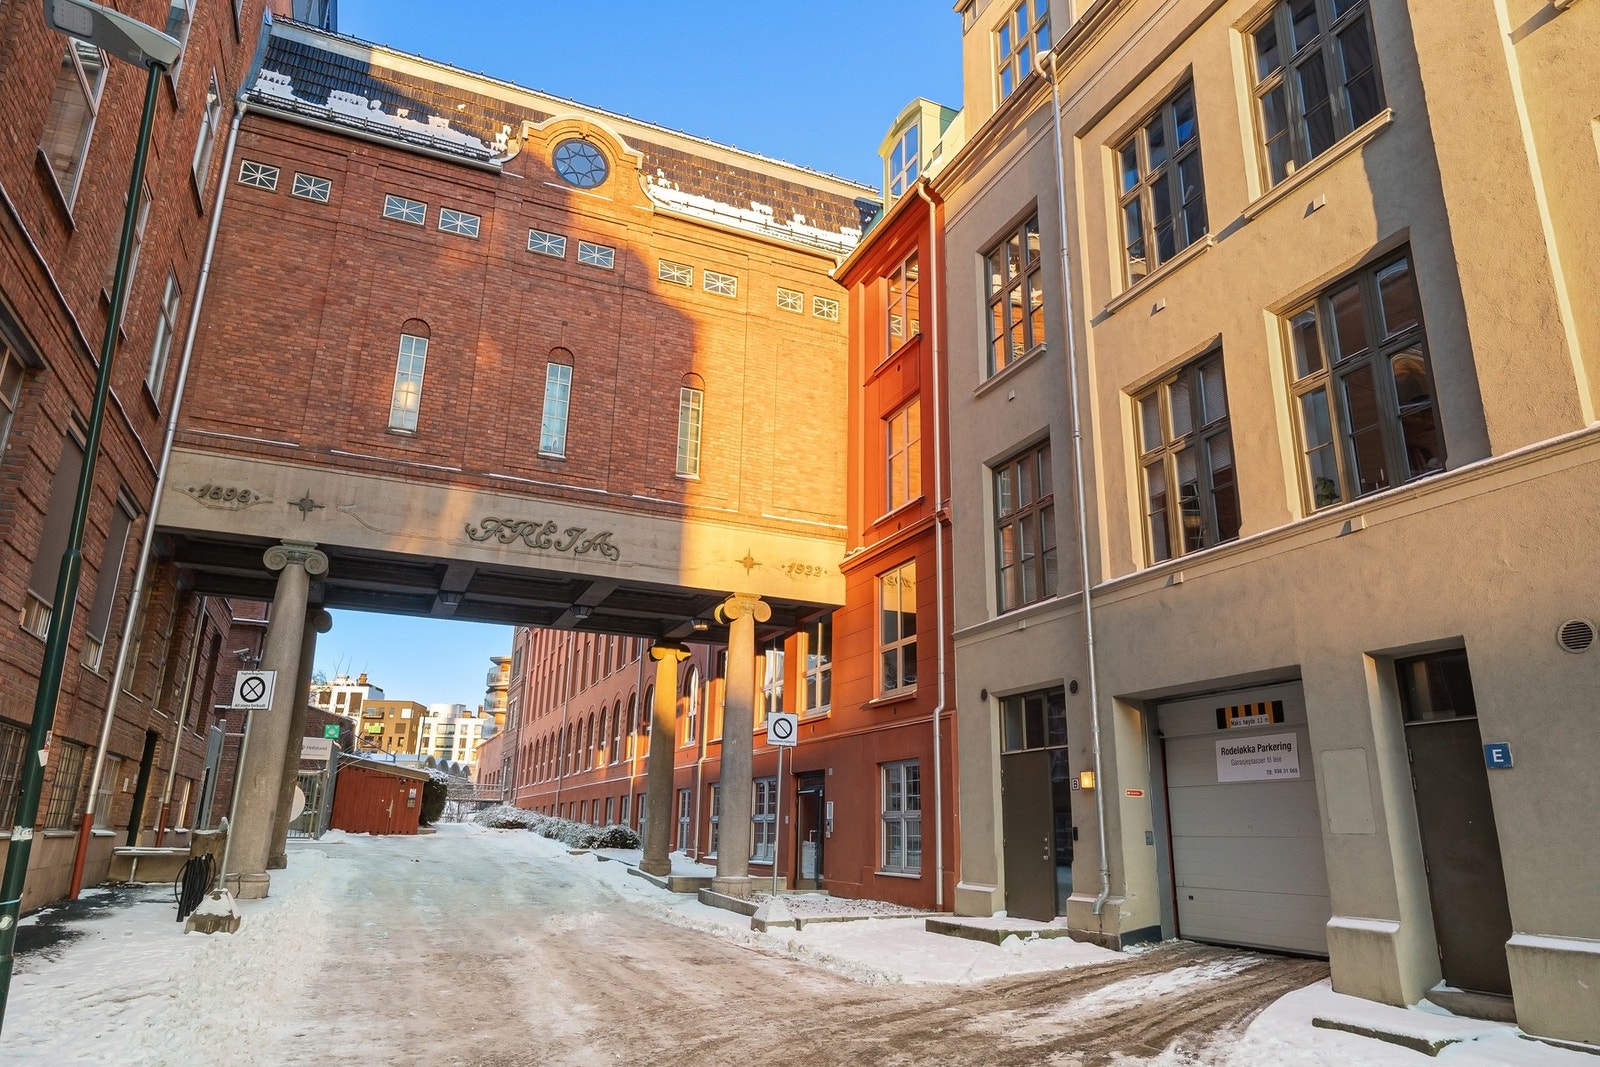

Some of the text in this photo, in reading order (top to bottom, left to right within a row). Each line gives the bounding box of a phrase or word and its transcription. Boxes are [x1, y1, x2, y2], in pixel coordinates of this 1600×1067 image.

[197, 484, 251, 503] 1898
[787, 562, 822, 577] 1922
[1221, 742, 1292, 756] Rodeløkka Parkering
[1492, 749, 1504, 763] E
